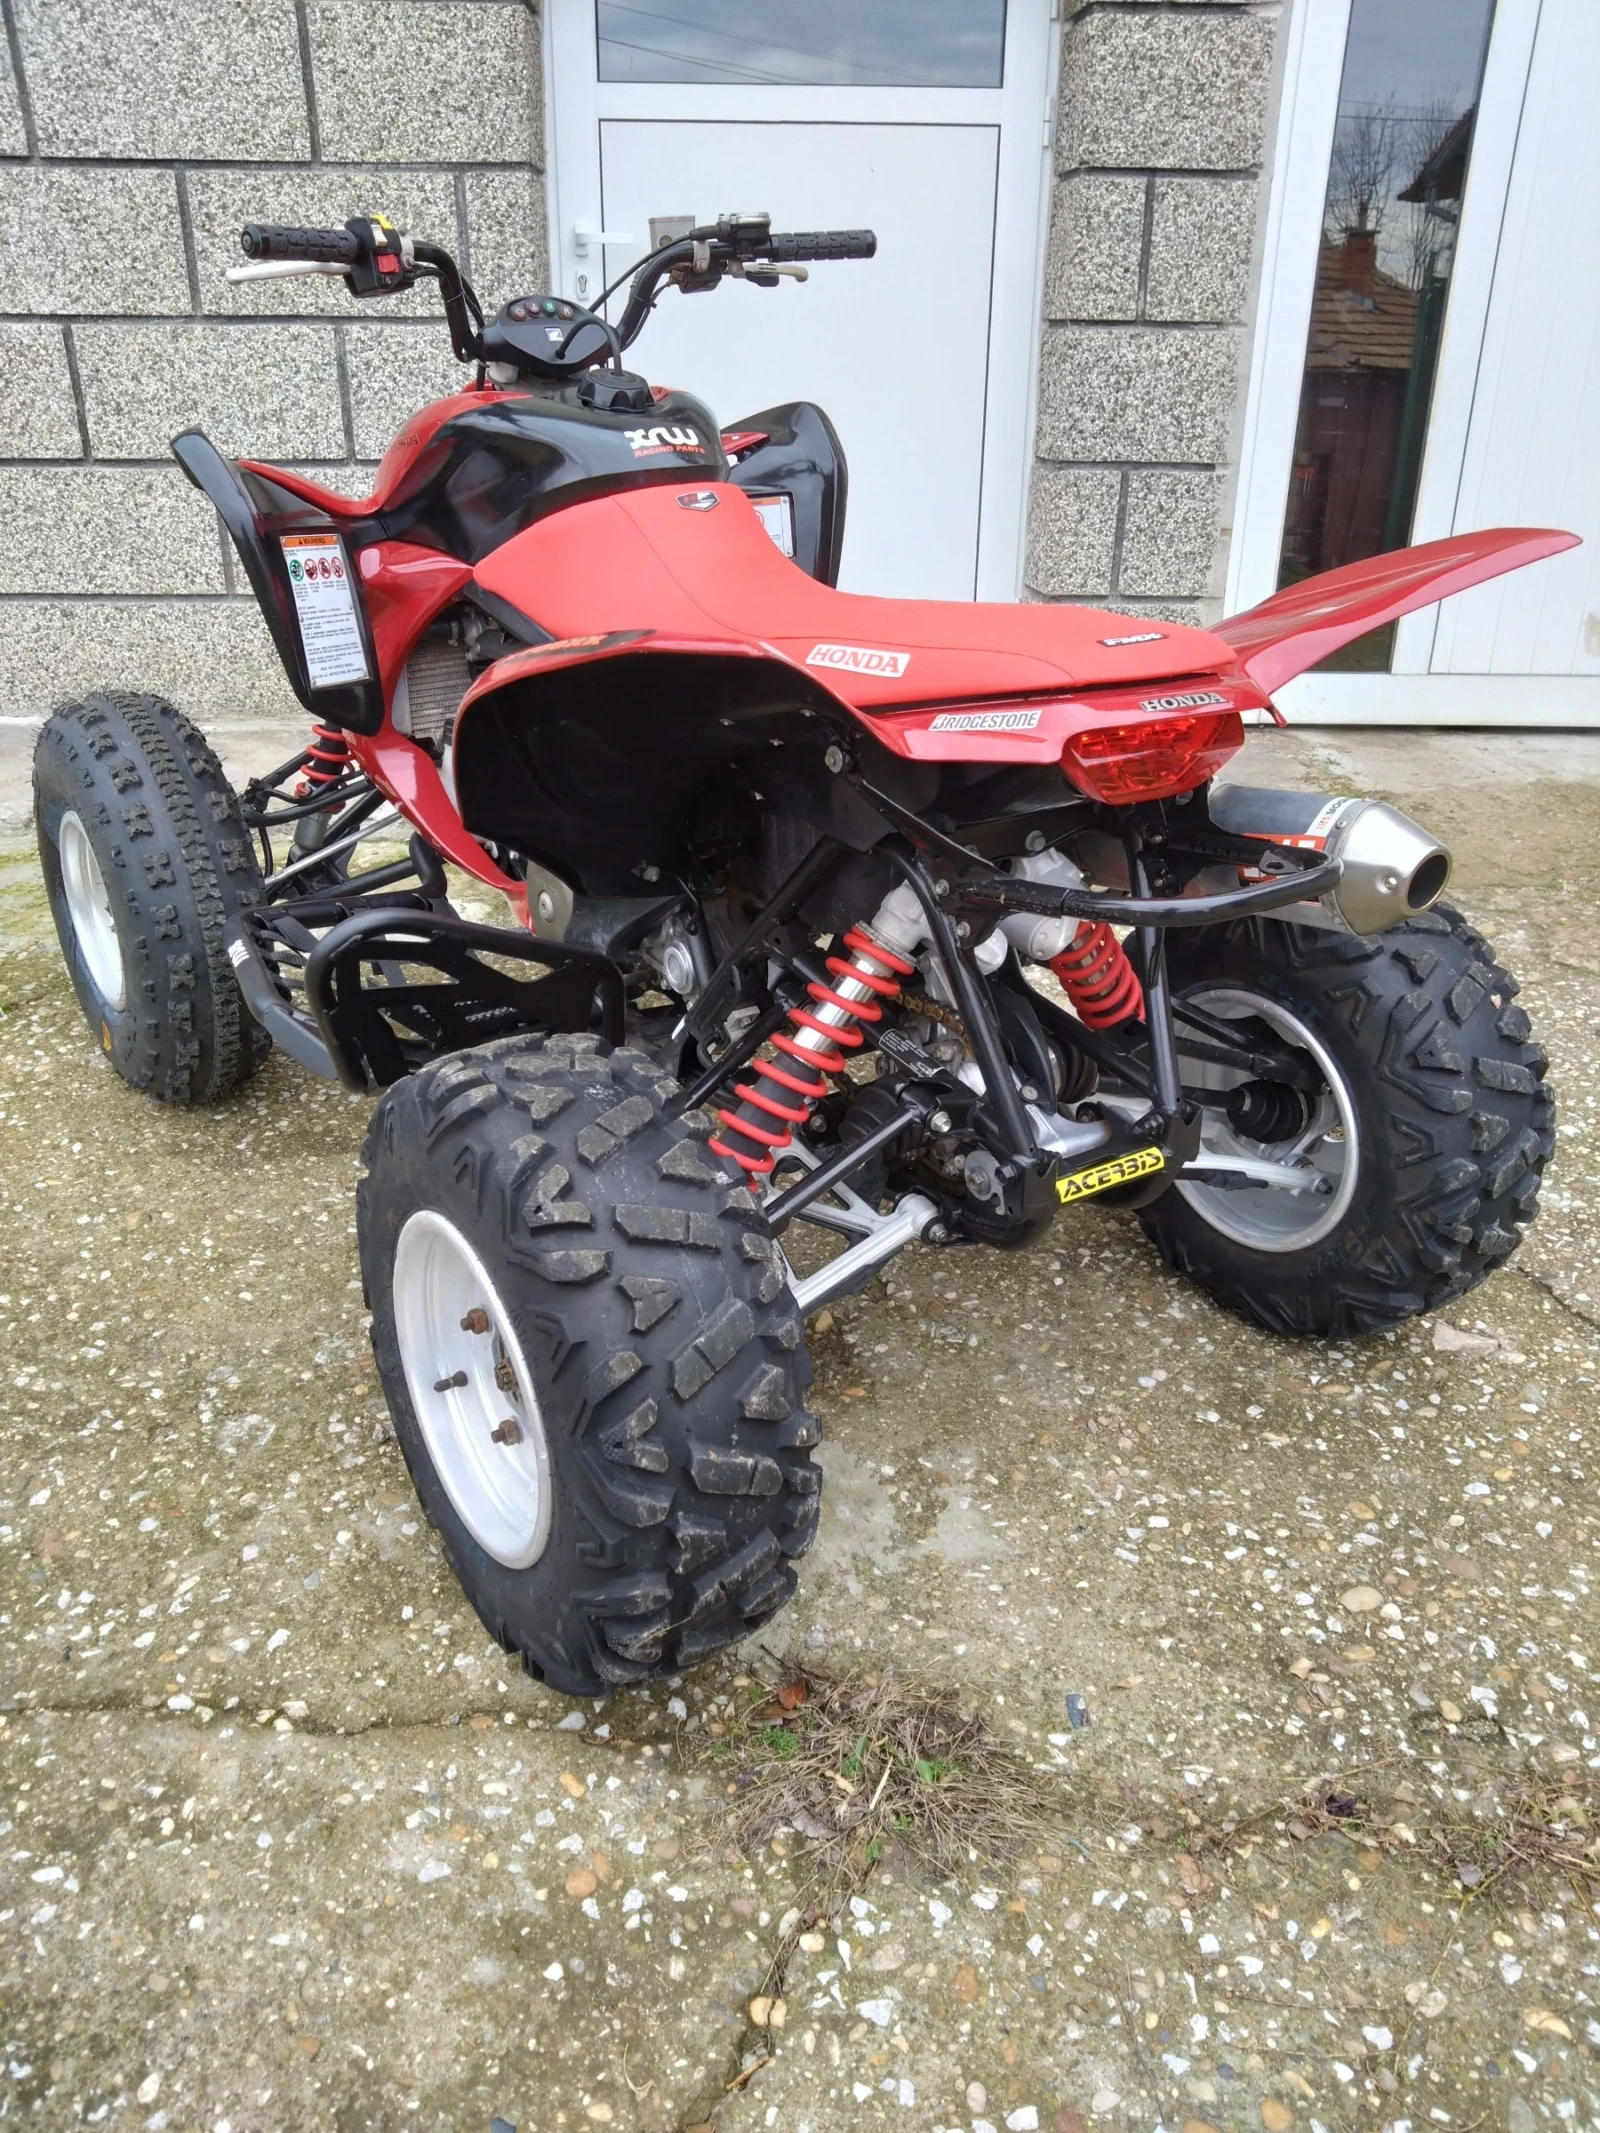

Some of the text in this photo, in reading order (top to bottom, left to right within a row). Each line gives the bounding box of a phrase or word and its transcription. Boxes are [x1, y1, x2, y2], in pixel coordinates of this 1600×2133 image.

[634, 444, 706, 458] RACING PARTS
[811, 647, 900, 673] HONDA
[1140, 692, 1228, 712] HONDA
[932, 712, 1039, 730] BRIDGESTONE
[1063, 1152, 1162, 1199] ACERBIS
